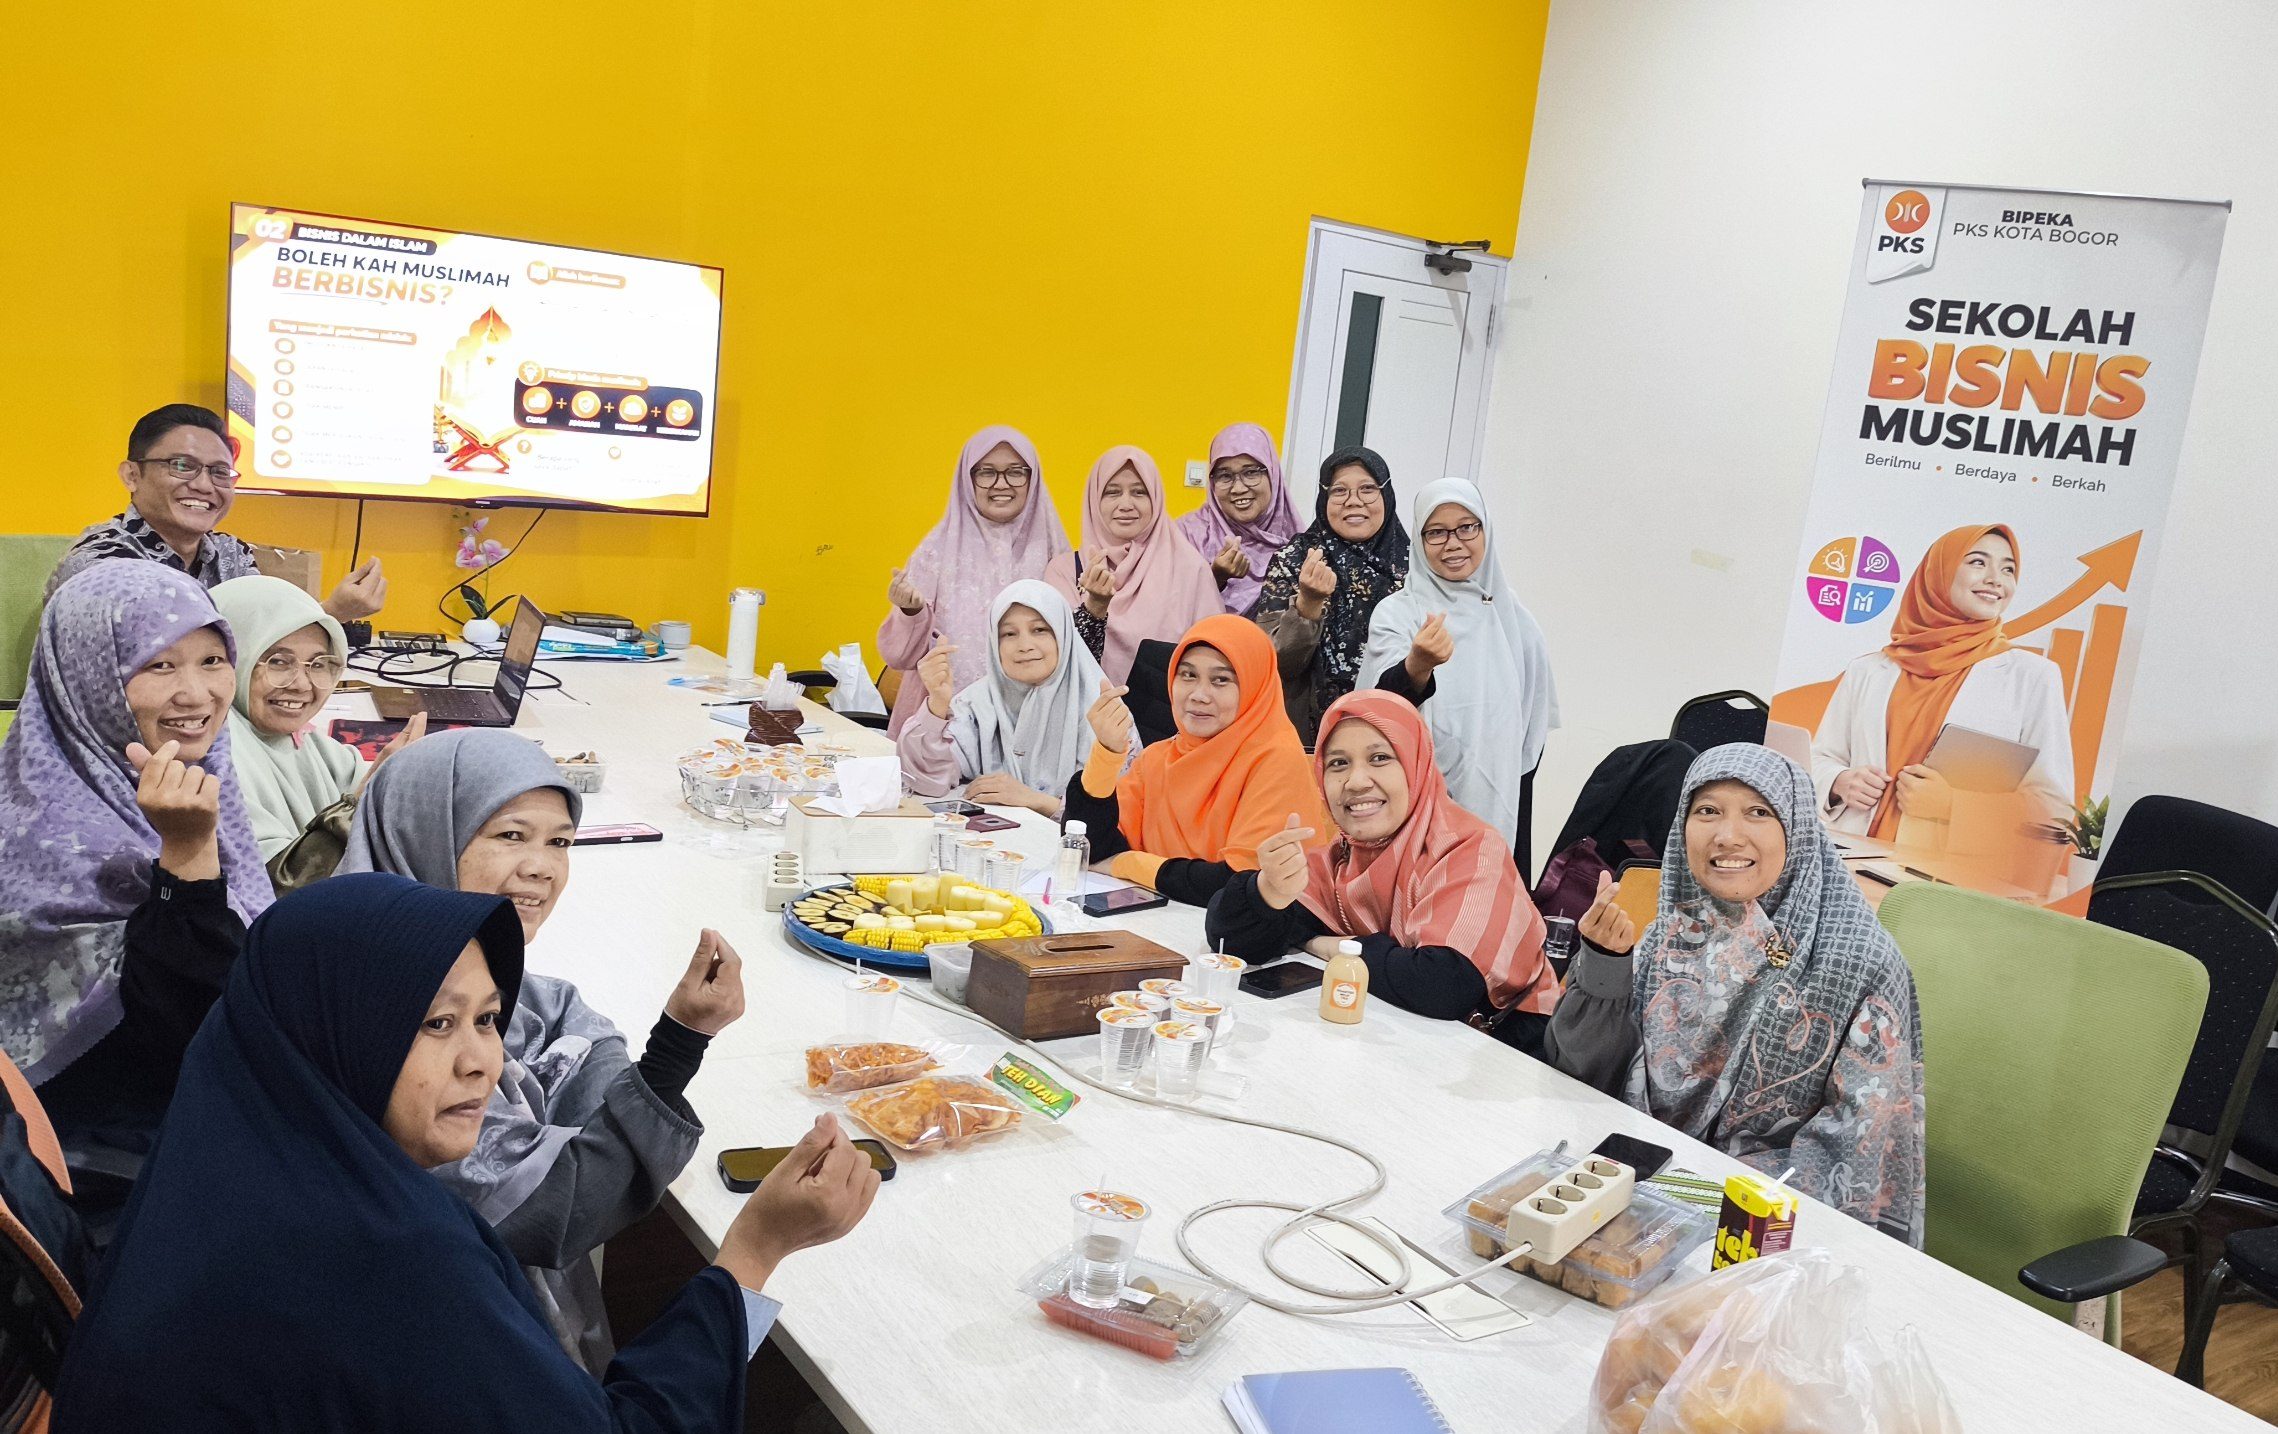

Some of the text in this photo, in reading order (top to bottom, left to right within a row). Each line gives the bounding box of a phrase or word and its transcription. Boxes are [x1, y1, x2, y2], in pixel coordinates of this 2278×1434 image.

[255, 218, 287, 240] 02
[1953, 222, 2119, 247] PKS KOTA BOGOR
[2001, 209, 2074, 227] BIPEKA
[297, 226, 428, 253] BISNIS DALAM ISLAM
[1877, 235, 1925, 254] PKS
[277, 247, 510, 288] BOLEH KAH MUSLIMAH
[272, 265, 454, 306] BERBISNIS?
[1905, 297, 2136, 346] SEKOLAH
[1867, 338, 2152, 420] BISNIS
[1859, 404, 2138, 466] MUSLIMAH
[1864, 453, 2106, 493] Berilmu Berdaya Berkah
[1001, 1064, 1028, 1085] TEH
